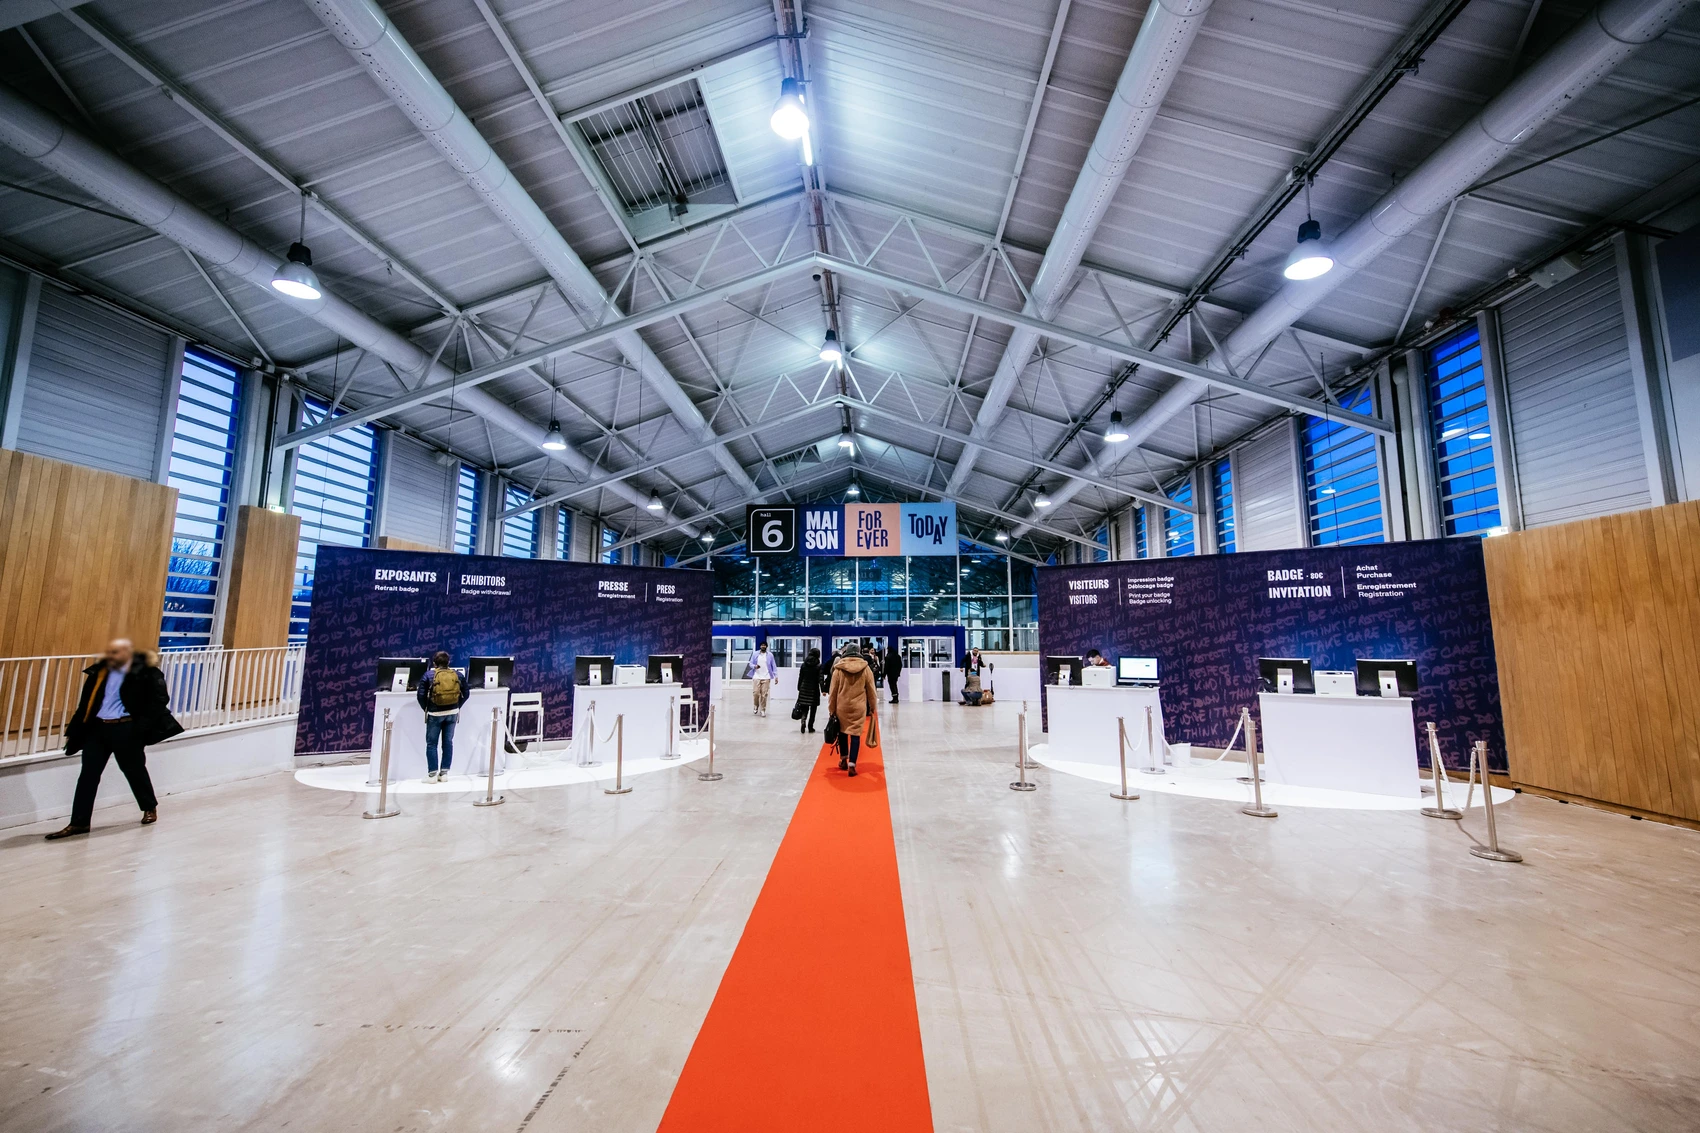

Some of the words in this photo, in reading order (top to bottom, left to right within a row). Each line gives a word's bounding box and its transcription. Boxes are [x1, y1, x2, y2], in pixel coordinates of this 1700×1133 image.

[806, 511, 838, 530] MAI
[858, 510, 882, 531] FOR
[762, 520, 784, 548] 6
[908, 513, 949, 545] TODAY
[805, 530, 839, 550] SON
[857, 529, 889, 550] EVER
[1356, 564, 1379, 572] Achat
[374, 569, 437, 583] EXPOSANTS
[461, 574, 506, 587] EXHIBITORS
[1267, 569, 1304, 582] BADGE
[1356, 571, 1393, 580] Purchase
[374, 584, 398, 592] Retrait
[399, 585, 419, 593] badge
[598, 580, 629, 592] PRESSE
[656, 584, 676, 595] PRESS
[1068, 579, 1109, 590] VISITEURS
[1356, 582, 1417, 592] Enregistrement
[461, 588, 480, 596] Badge
[1268, 585, 1332, 599] INVITATION
[1358, 590, 1404, 599] Registration
[1069, 594, 1098, 605] VISITORS
